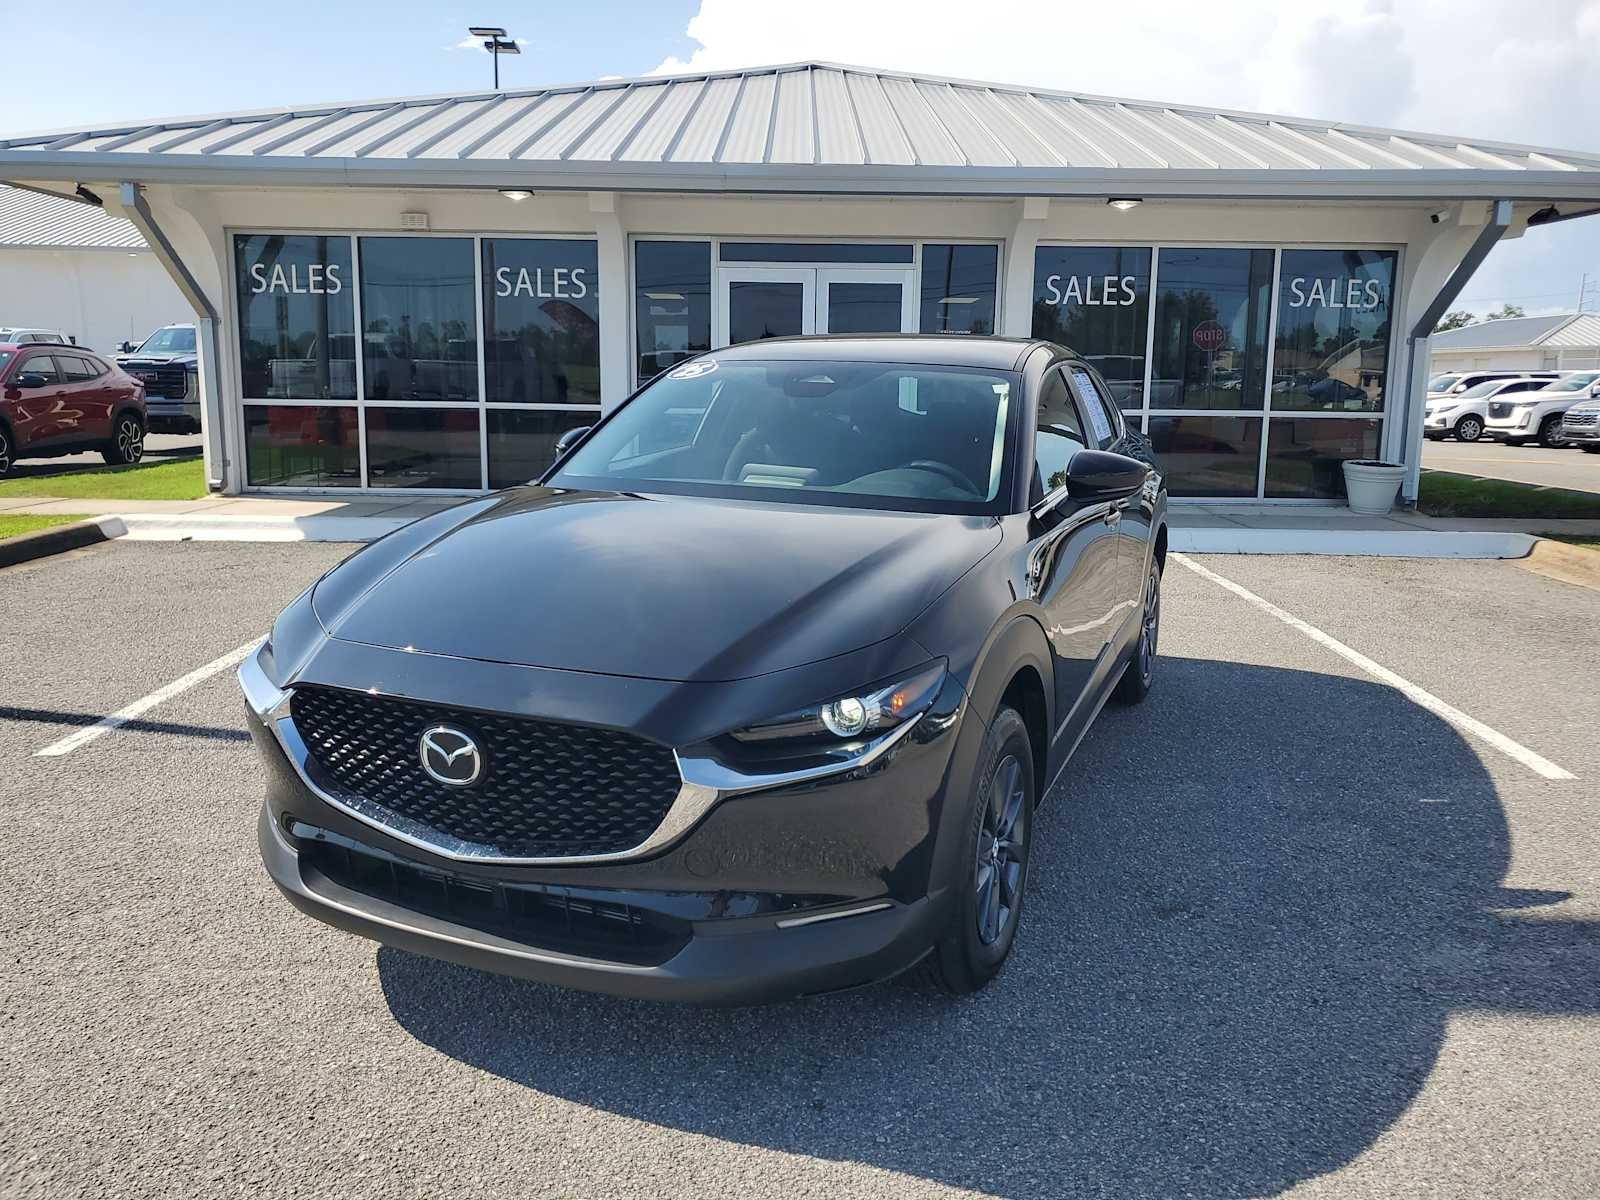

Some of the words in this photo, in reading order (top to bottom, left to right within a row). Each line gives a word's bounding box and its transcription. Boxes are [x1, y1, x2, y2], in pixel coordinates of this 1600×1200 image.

[251, 263, 342, 294] SALES
[496, 266, 587, 298] SALES
[1045, 274, 1136, 306] SALES
[1289, 277, 1380, 309] SALES
